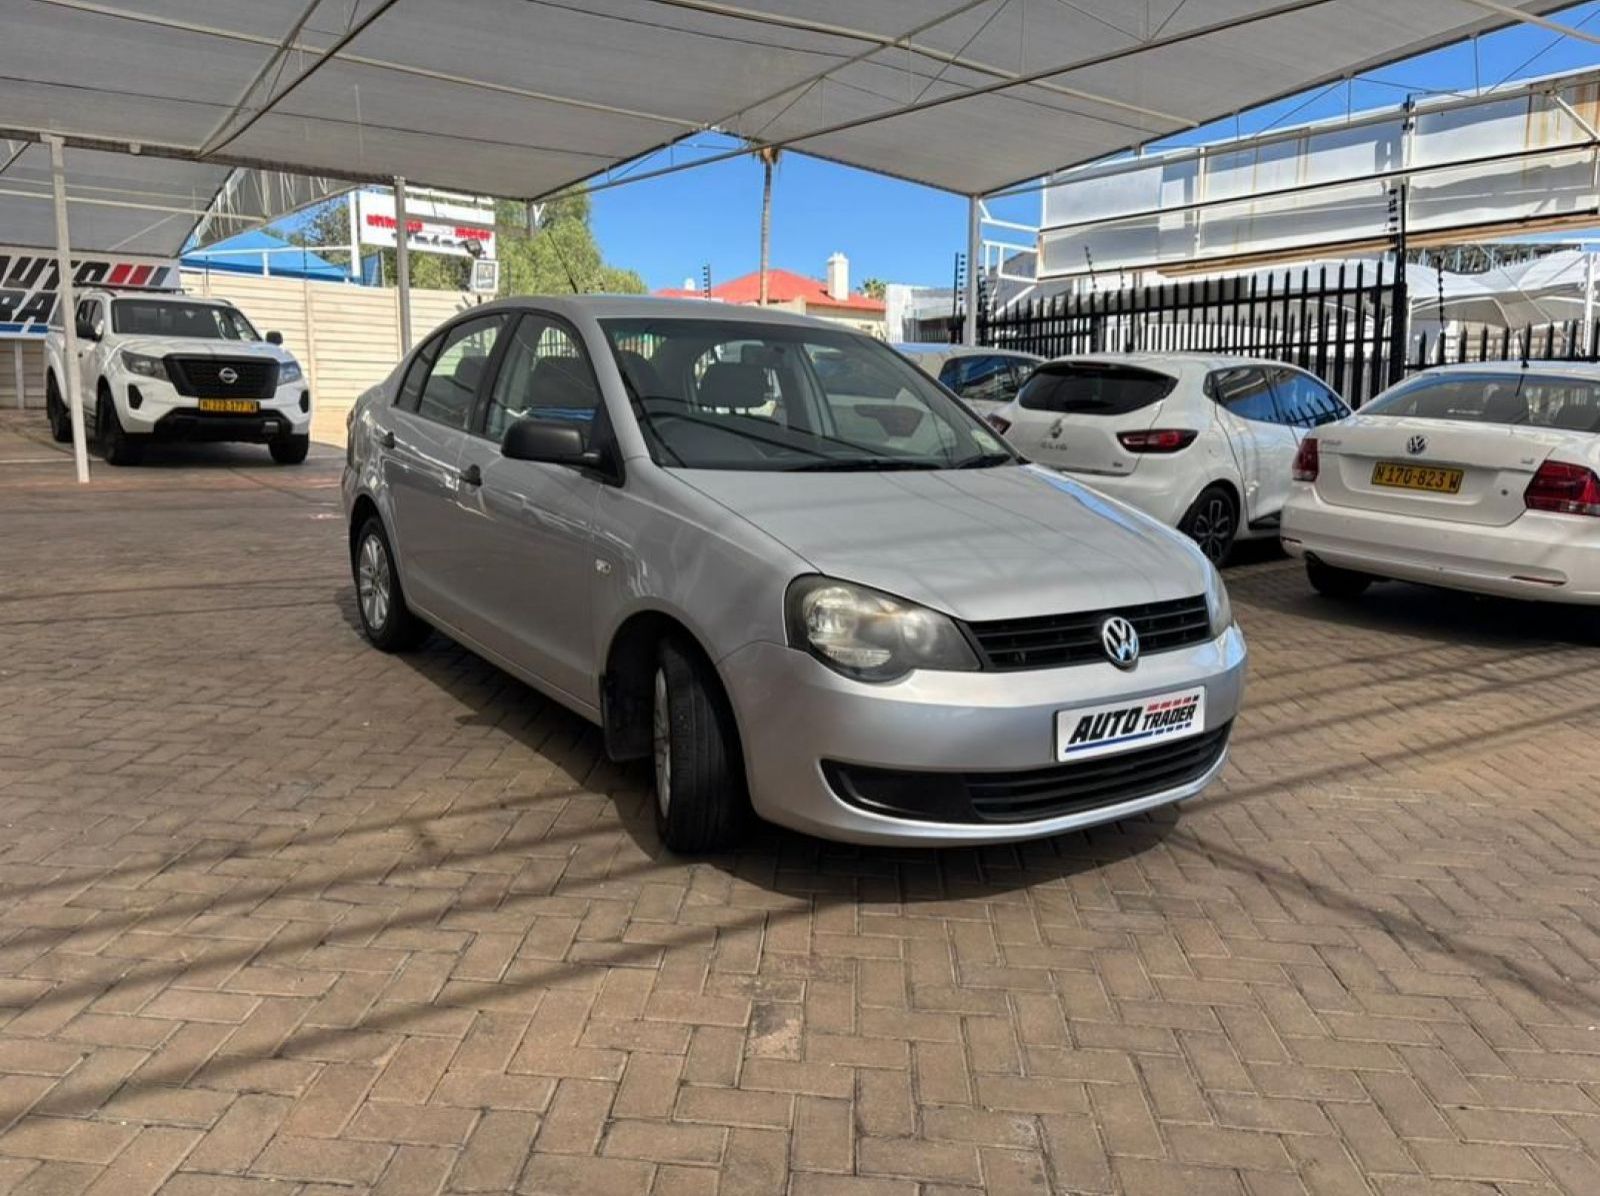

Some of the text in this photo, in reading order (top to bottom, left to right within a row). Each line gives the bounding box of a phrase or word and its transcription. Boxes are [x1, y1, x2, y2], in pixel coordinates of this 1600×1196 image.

[1375, 465, 1460, 489] N 170-823 W
[1068, 703, 1198, 745] AUTO TRADER
